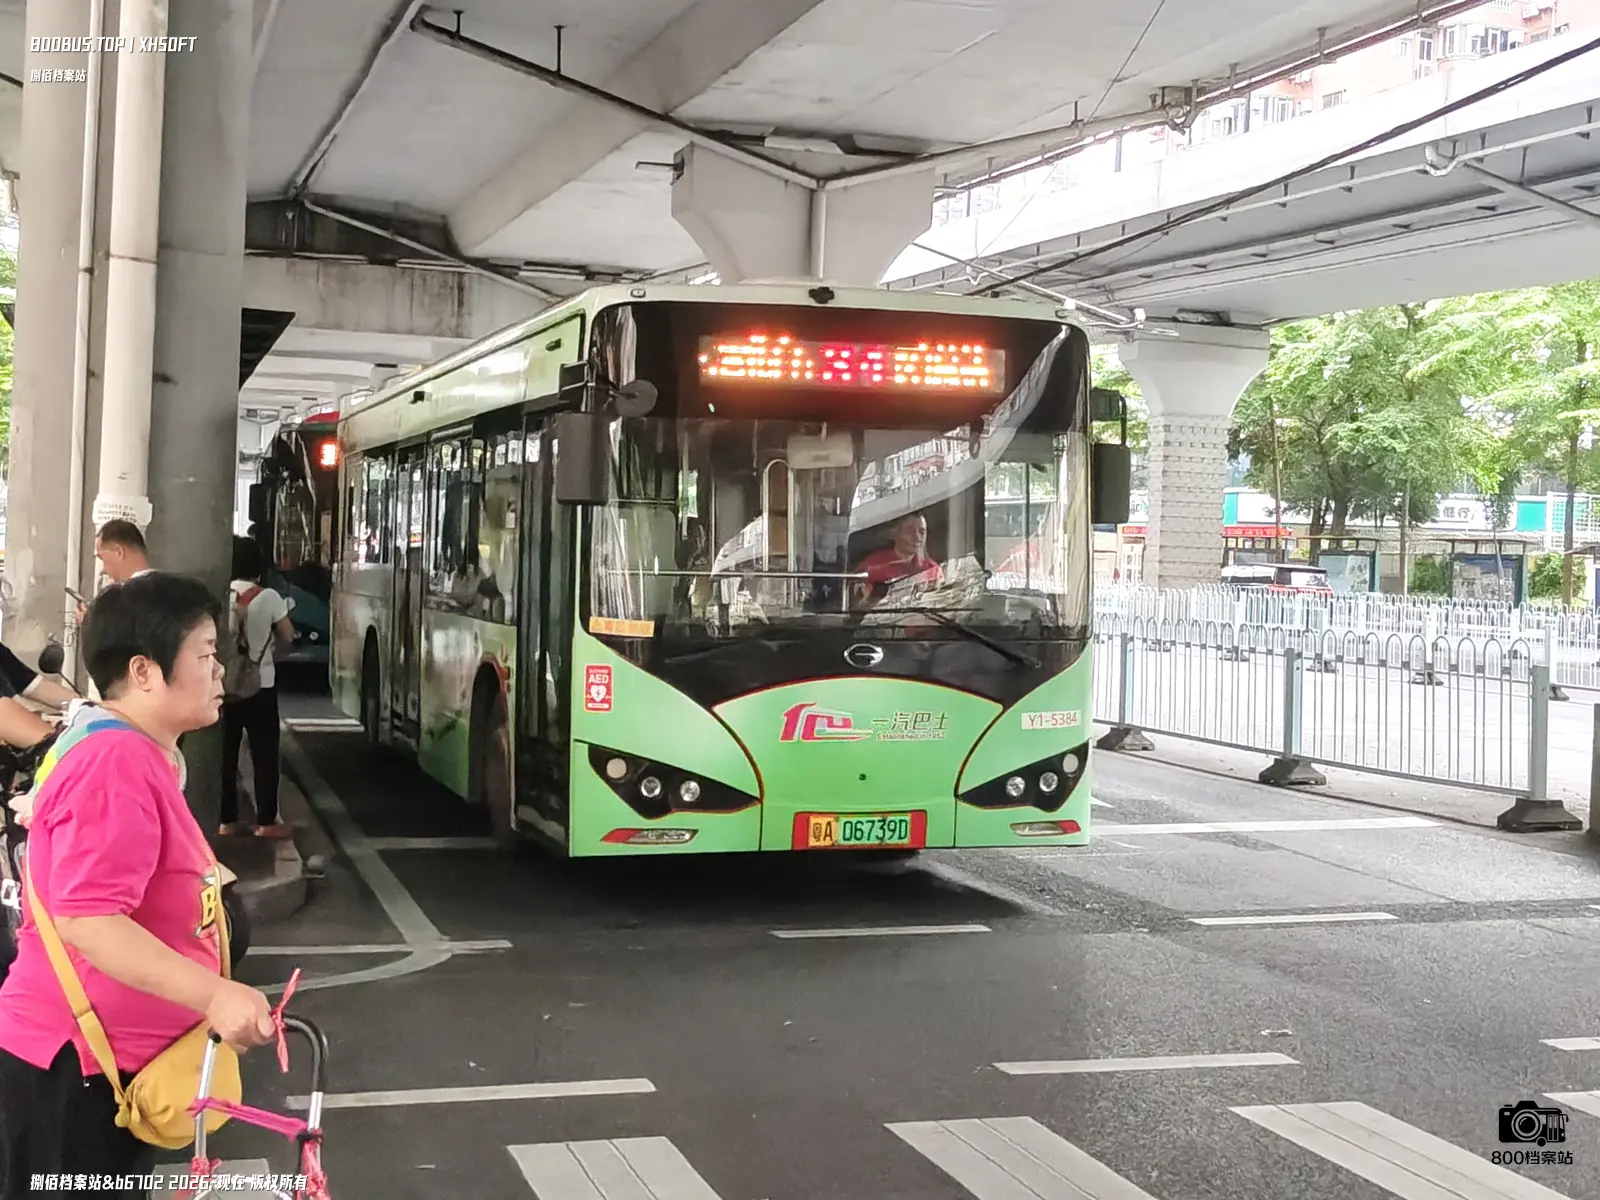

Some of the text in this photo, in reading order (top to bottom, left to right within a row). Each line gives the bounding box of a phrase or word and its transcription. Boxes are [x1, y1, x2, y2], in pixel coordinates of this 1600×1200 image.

[589, 674, 609, 684] AED
[873, 711, 949, 731] 一汽巴士
[1028, 711, 1077, 727] Y1-5384
[842, 818, 908, 842] 06739D
